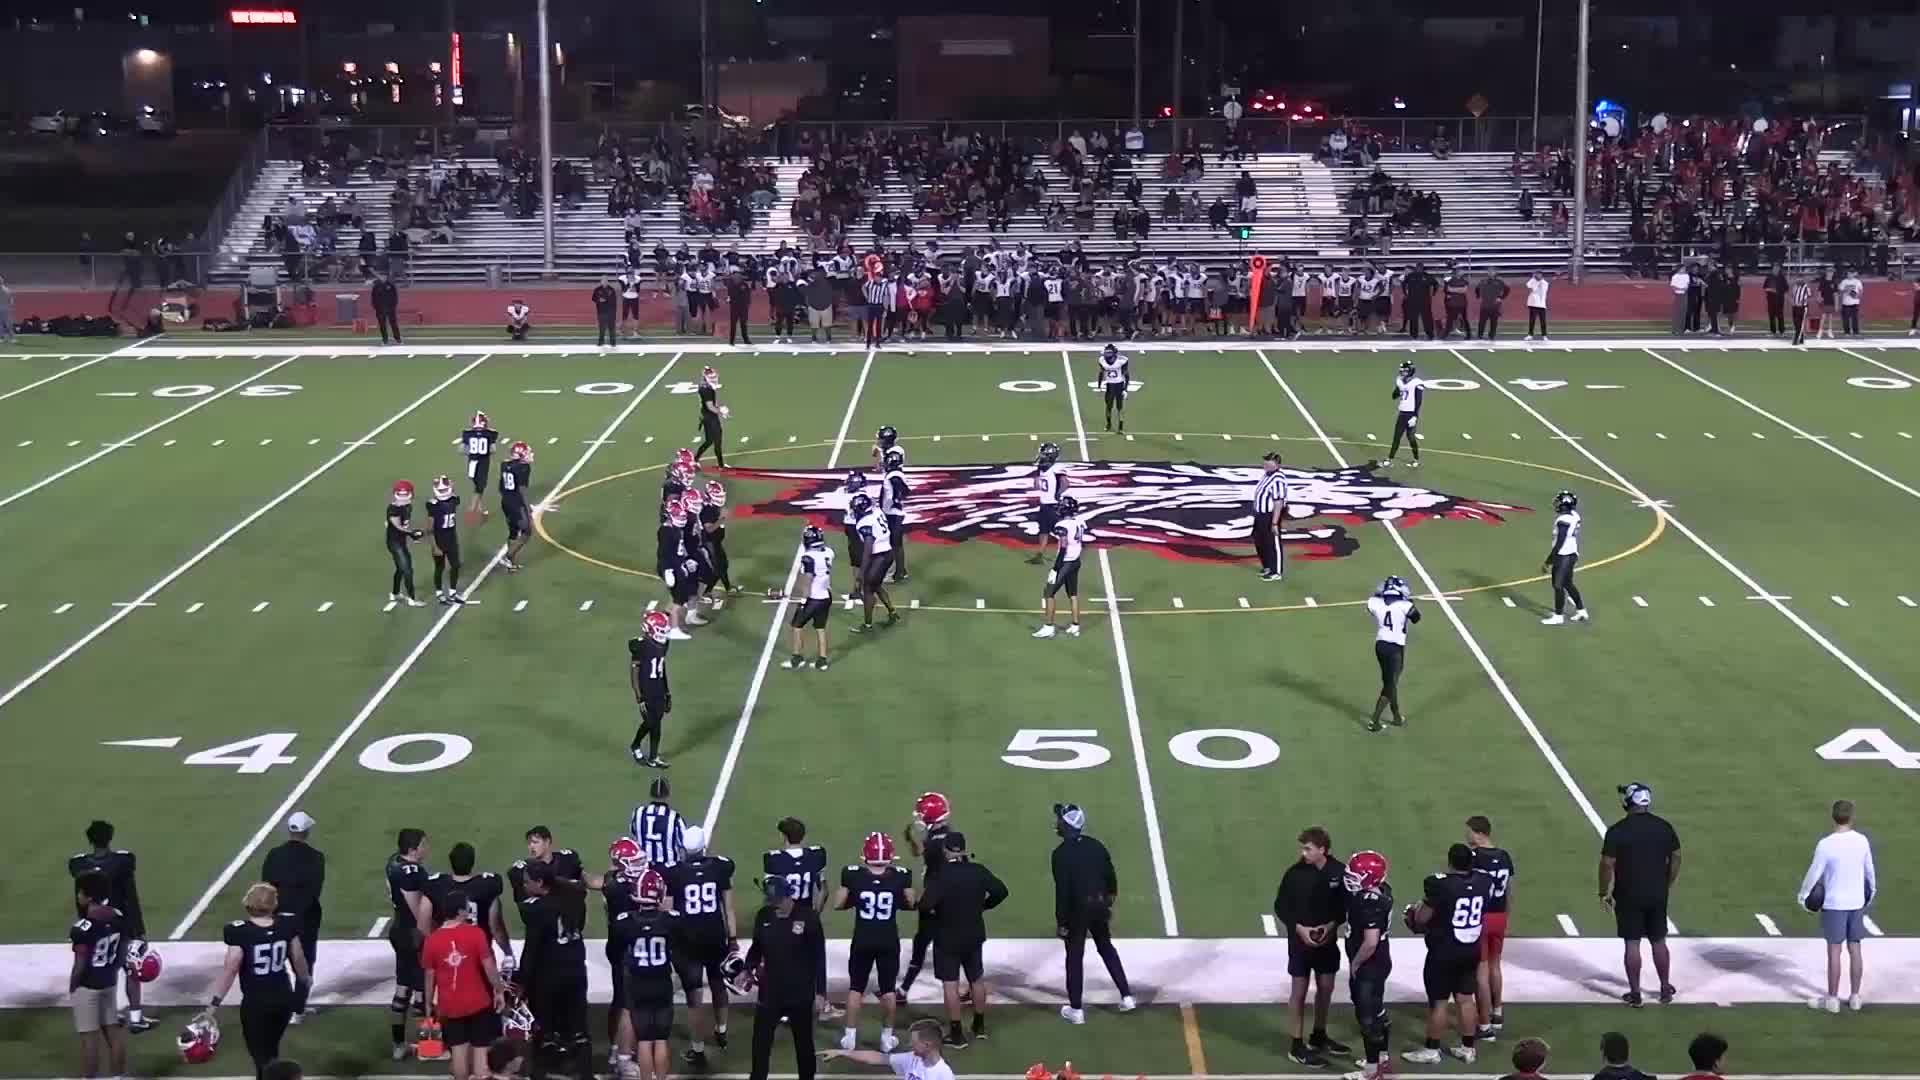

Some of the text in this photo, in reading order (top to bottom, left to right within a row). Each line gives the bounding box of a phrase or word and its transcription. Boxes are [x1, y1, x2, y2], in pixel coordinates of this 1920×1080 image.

[469, 437, 488, 455] 80
[503, 472, 516, 491] 18
[1383, 610, 1394, 632] 4
[649, 657, 665, 679] 14
[184, 732, 473, 773] 40
[1000, 727, 1280, 770] 50
[646, 815, 662, 841] L
[684, 882, 717, 915] 89
[859, 891, 894, 921] 39
[1452, 895, 1484, 928] 68
[253, 940, 287, 976] 50
[633, 936, 666, 967] 40
